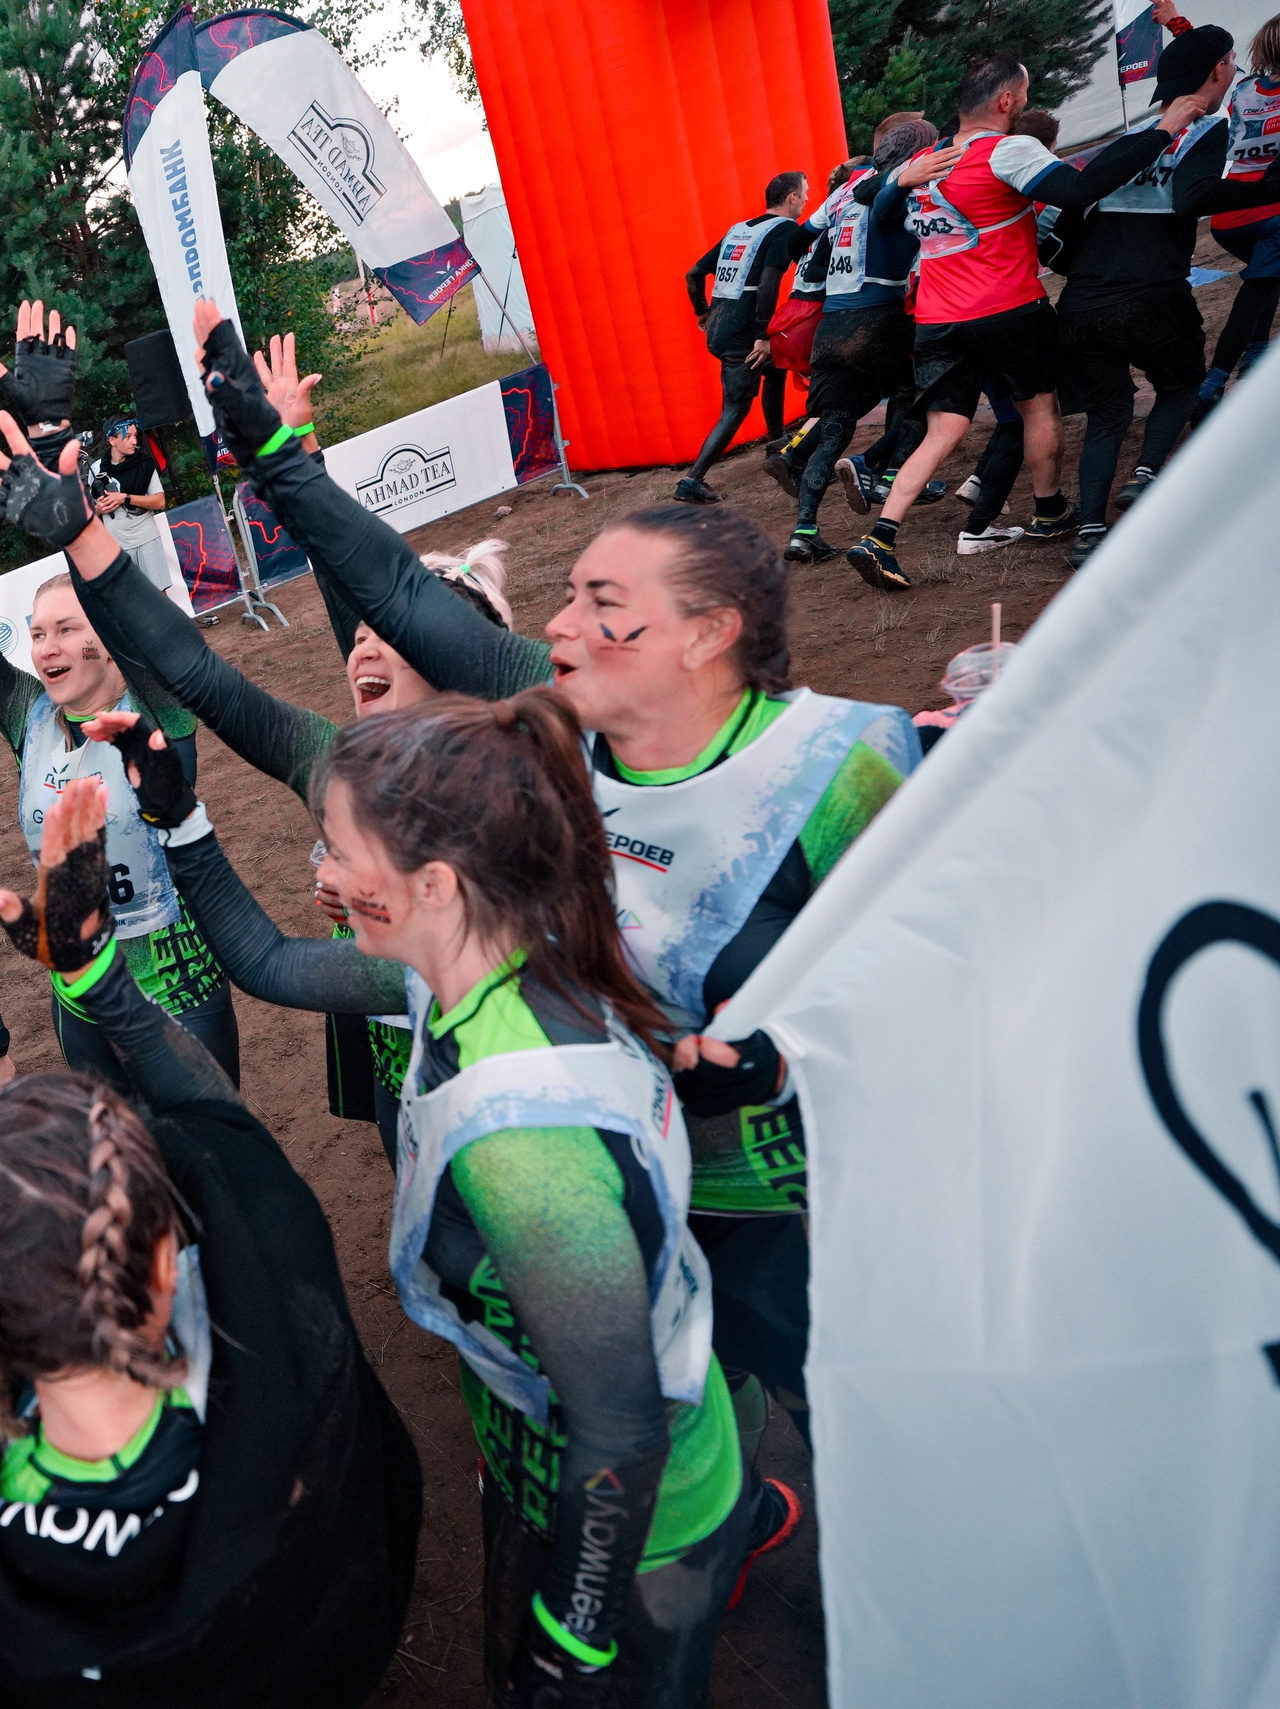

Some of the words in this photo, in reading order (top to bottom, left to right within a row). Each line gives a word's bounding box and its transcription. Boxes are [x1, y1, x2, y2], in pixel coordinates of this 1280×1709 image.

[1118, 60, 1149, 73] ЕРОЕВ
[363, 472, 420, 508] AHMAD
[420, 461, 452, 483] TEA
[394, 490, 425, 506] LONDON
[606, 831, 675, 866] ЕРОЕВ
[564, 1495, 630, 1643] eenway
